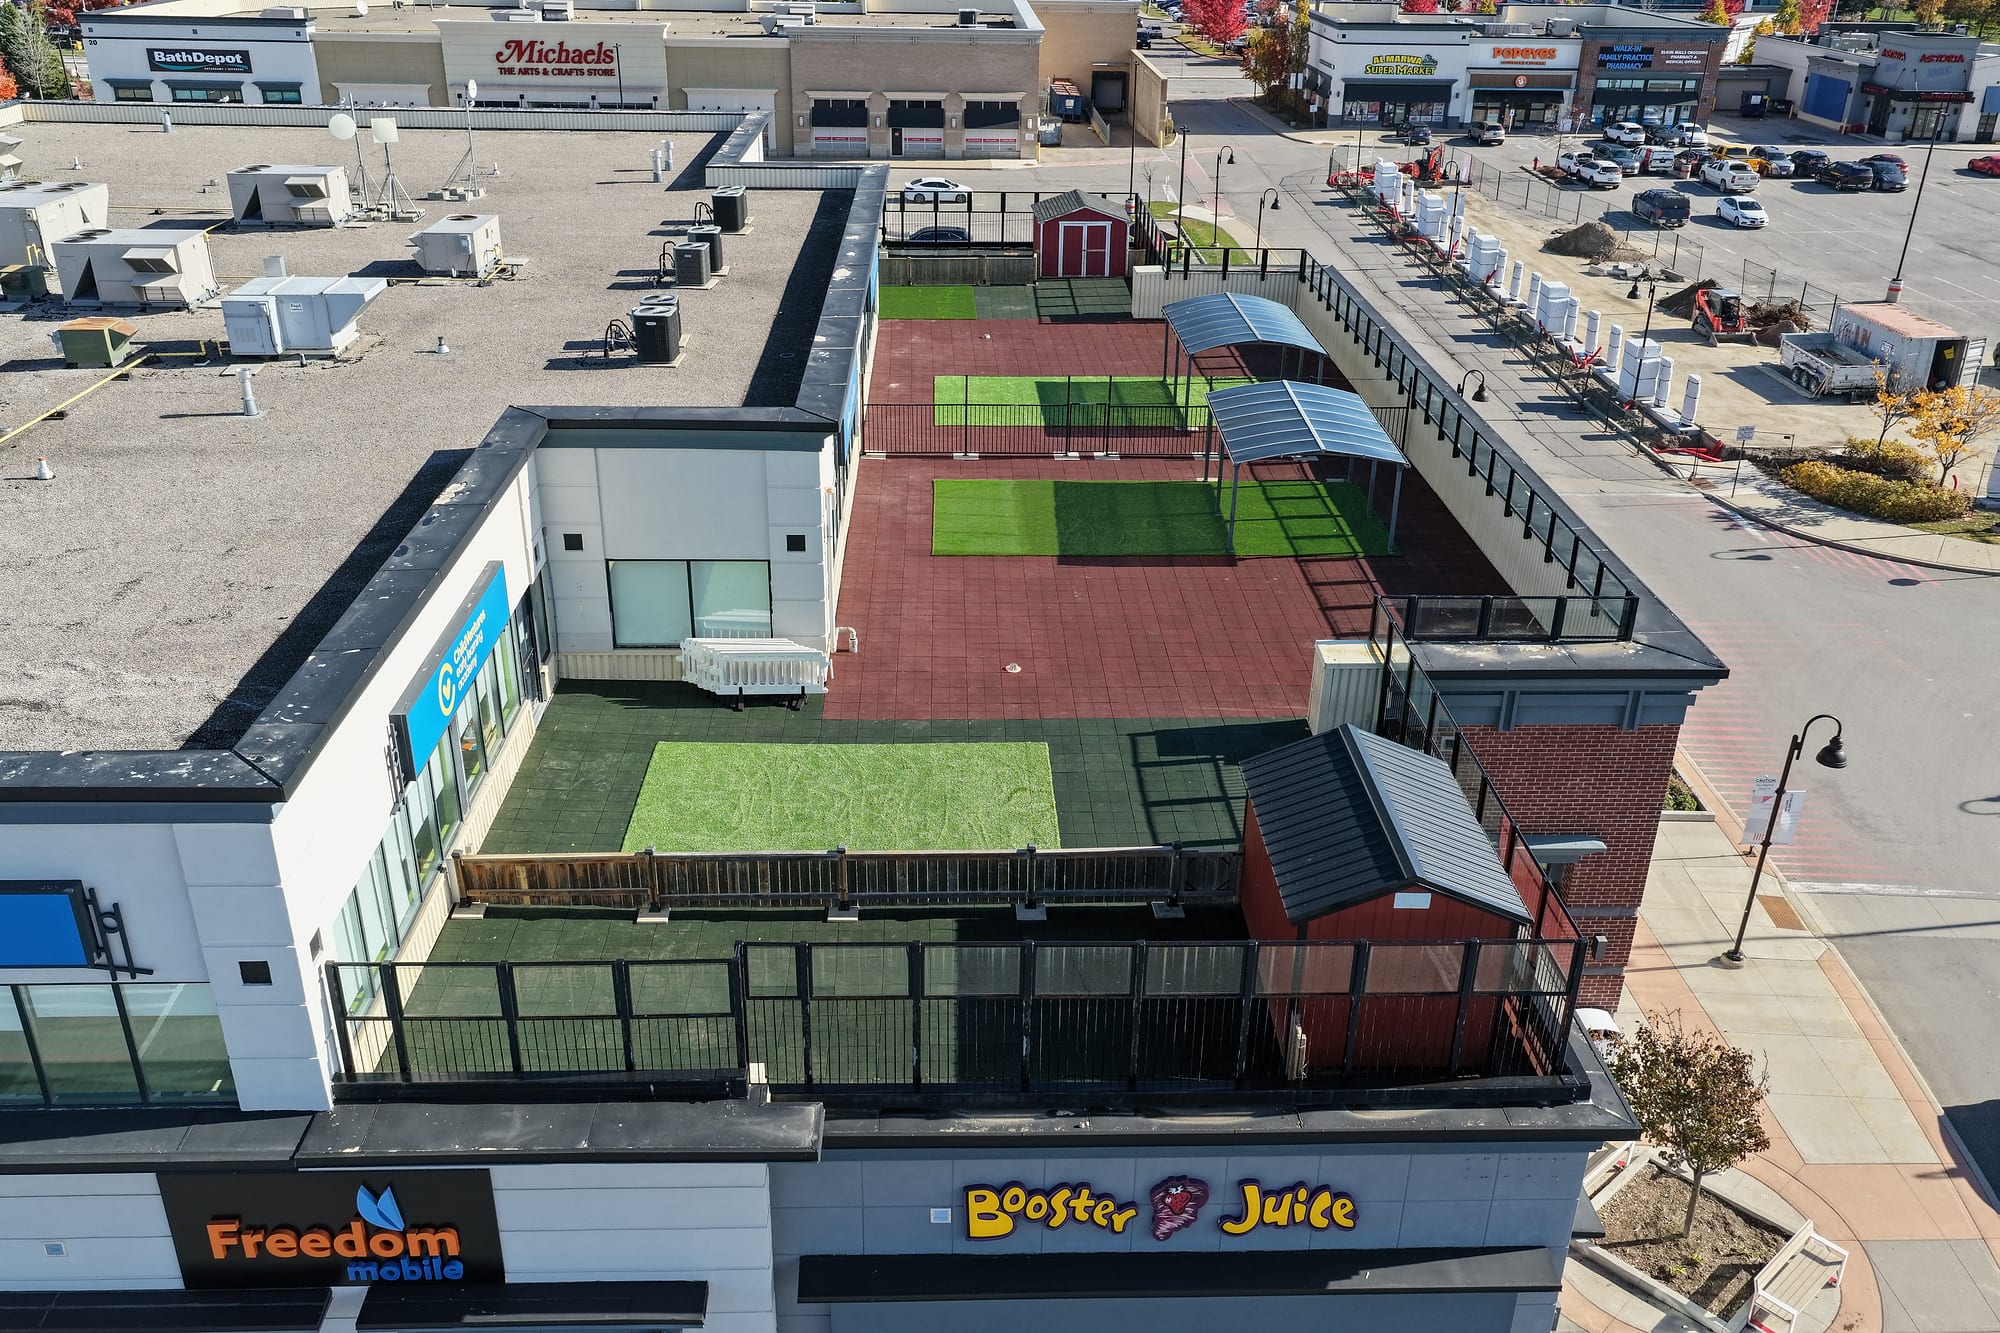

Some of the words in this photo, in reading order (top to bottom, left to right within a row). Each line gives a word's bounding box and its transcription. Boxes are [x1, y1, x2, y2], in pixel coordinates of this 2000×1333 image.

[153, 51, 243, 66] BathDepot
[495, 40, 614, 65] Michaels
[1372, 55, 1385, 64] AL
[1385, 54, 1423, 65] MARWA
[498, 67, 516, 76] THE
[518, 67, 540, 76] ARTS
[542, 68, 549, 76] &
[551, 68, 585, 76] CRAFTS
[586, 68, 616, 77] STORE
[1364, 64, 1394, 75] SUPER
[1396, 64, 1437, 75] MARKET
[1606, 62, 1643, 70] PHARMACY
[966, 1183, 1137, 1239] Booster
[1221, 1183, 1356, 1236] Juice
[205, 1219, 461, 1260] Freedom
[347, 1255, 464, 1281] mobile
